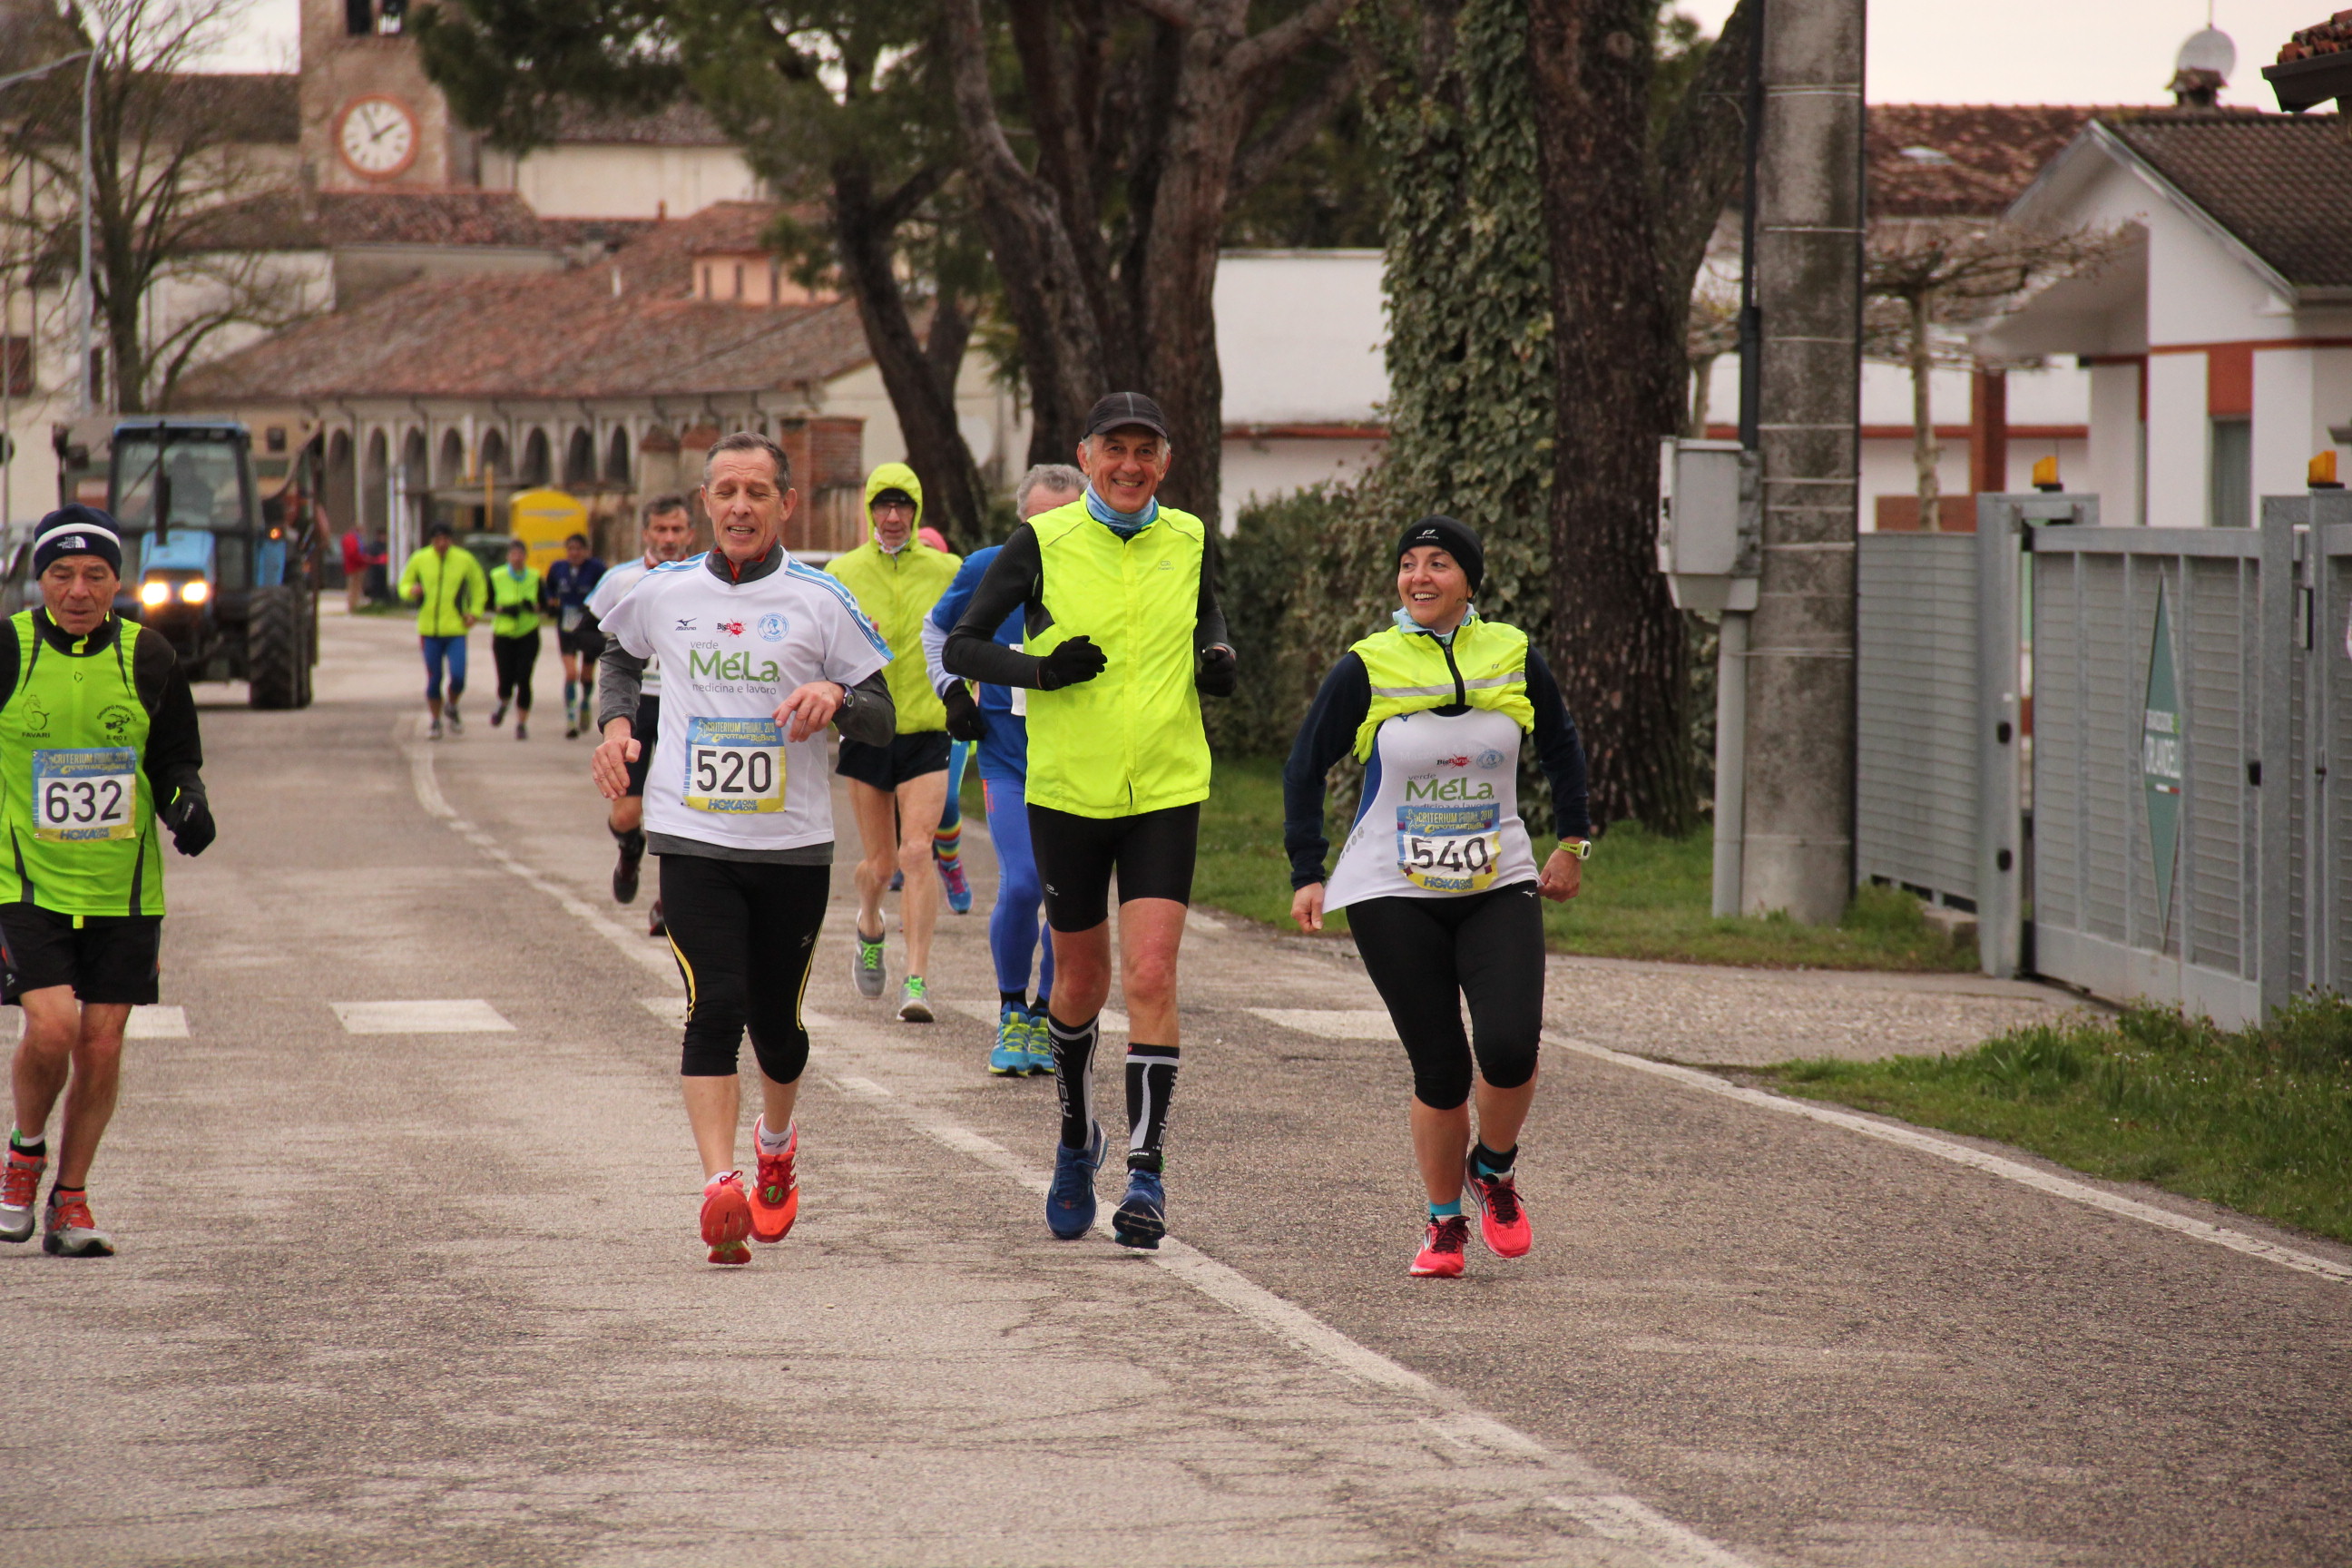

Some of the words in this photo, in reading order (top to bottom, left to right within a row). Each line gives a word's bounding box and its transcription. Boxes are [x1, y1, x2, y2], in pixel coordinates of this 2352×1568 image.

[691, 640, 718, 649] verde
[692, 684, 734, 693] medicina
[746, 684, 776, 695] lavoro
[707, 722, 741, 733] CRITERIUM
[53, 753, 92, 764] CRITERIUM
[696, 750, 771, 794] 520
[45, 780, 122, 823] 632
[708, 799, 743, 811] HOKA
[1419, 812, 1457, 823] CRITERIUM
[60, 829, 96, 840] HOKA
[1411, 837, 1488, 872] 540
[1424, 877, 1460, 890] HOKA
